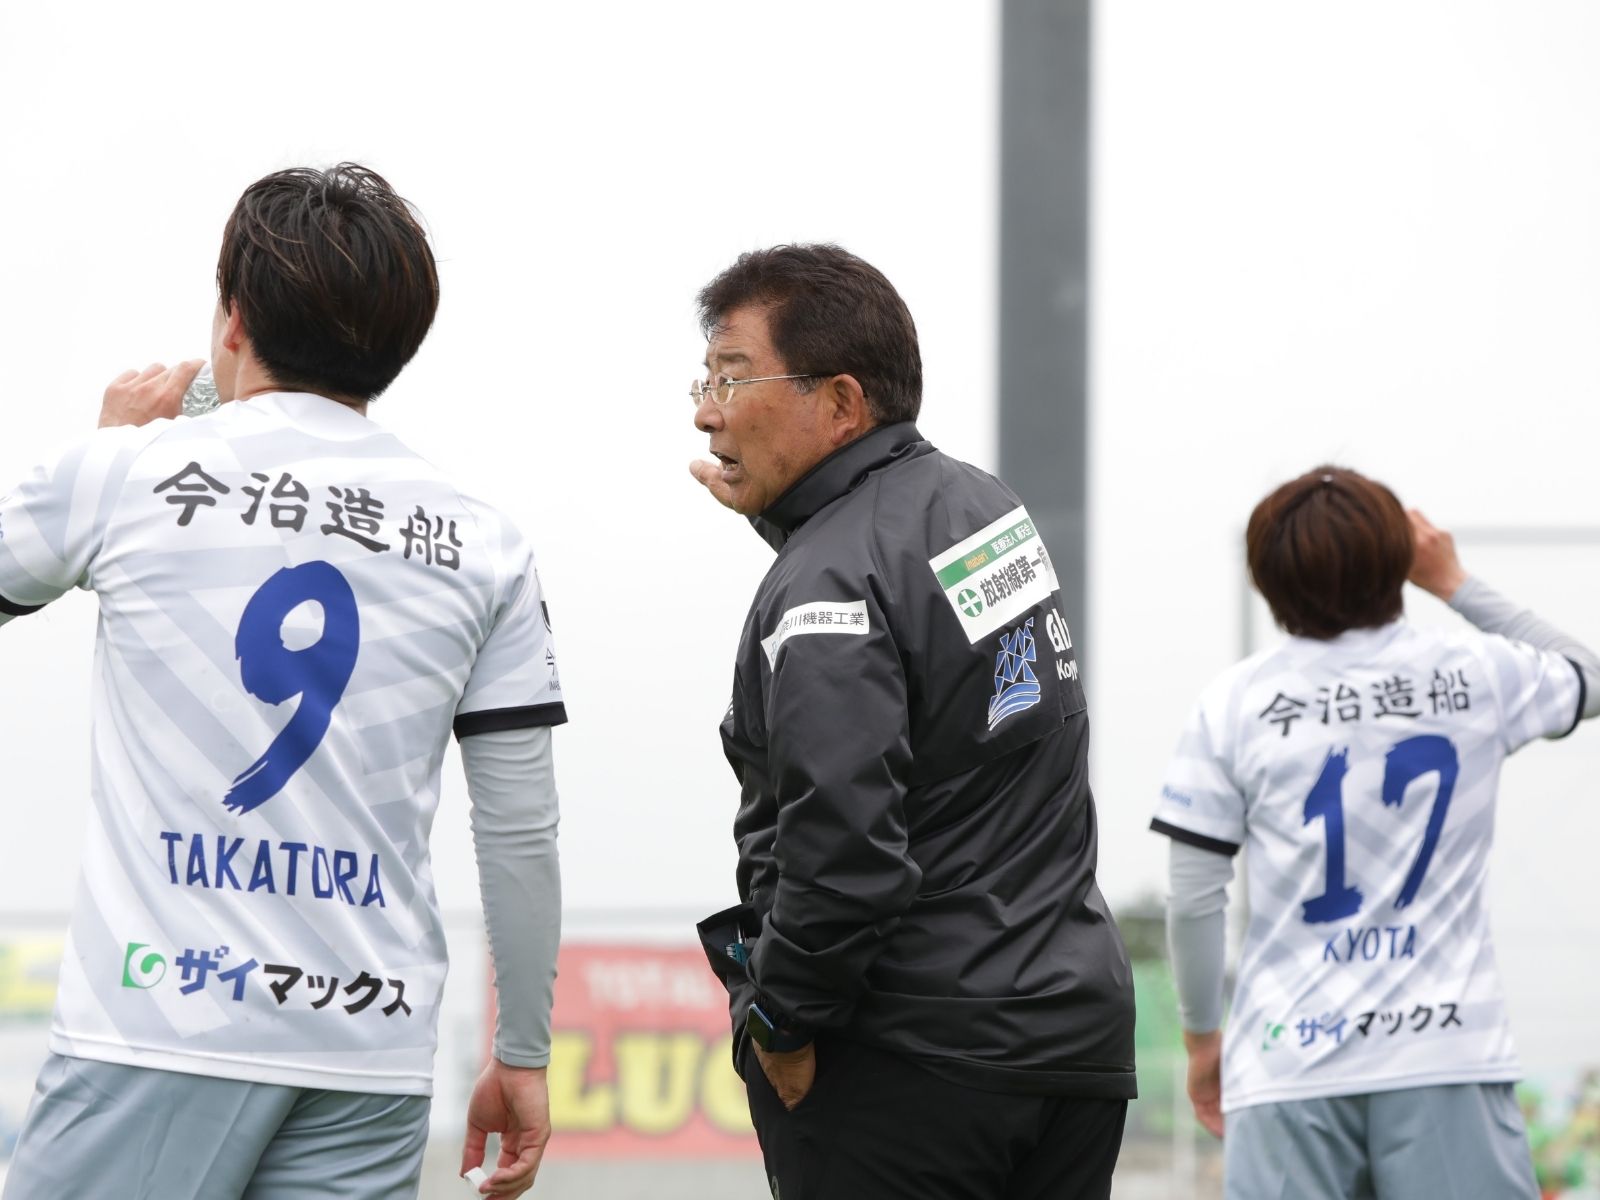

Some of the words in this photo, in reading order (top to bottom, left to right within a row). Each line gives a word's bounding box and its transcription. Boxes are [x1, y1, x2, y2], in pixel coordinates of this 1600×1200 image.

[153, 461, 463, 571] 今治造船
[221, 560, 360, 816] 9
[1259, 669, 1471, 738] 今治造船
[1302, 734, 1459, 924] 17
[160, 831, 386, 908] TAKATORA
[1323, 925, 1416, 962] KYOTA
[175, 945, 412, 1017] ザイマックス
[1296, 1003, 1463, 1047] ザイマックス
